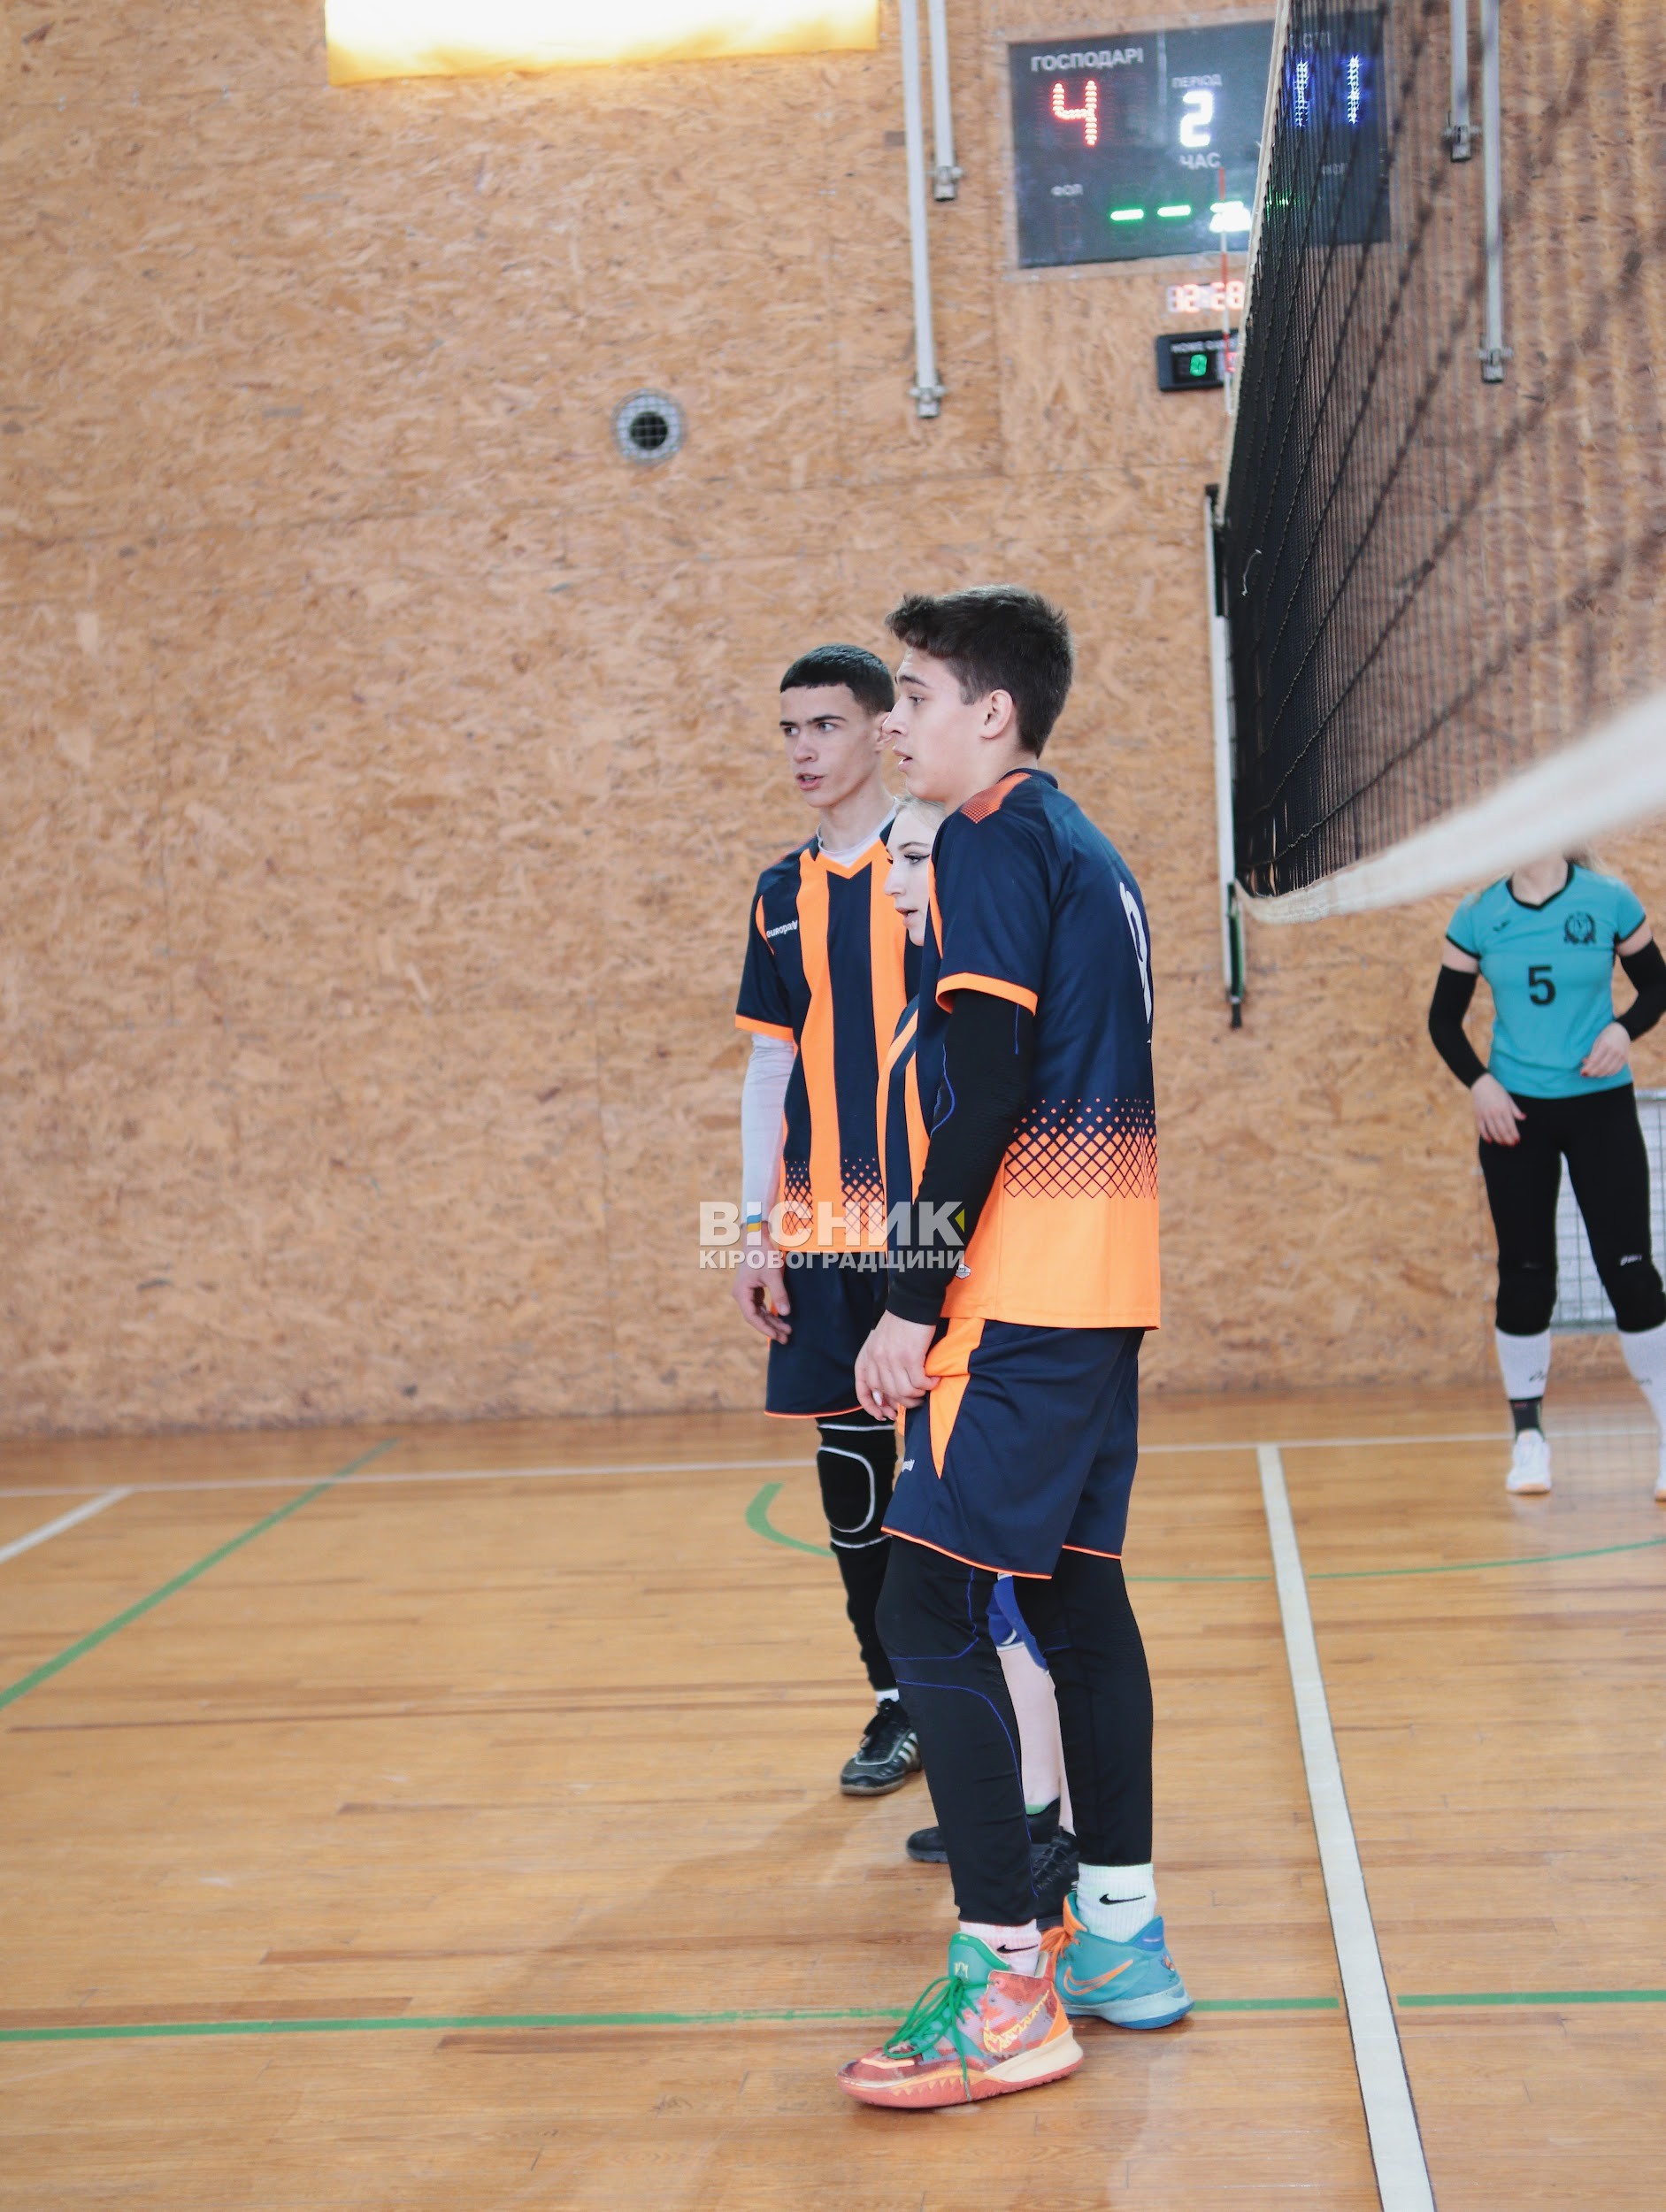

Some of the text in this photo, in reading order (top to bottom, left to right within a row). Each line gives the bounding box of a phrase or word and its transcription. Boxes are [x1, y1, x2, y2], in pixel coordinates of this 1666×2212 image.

[1030, 48, 1144, 72] ГОСПОДАРІ
[1052, 80, 1098, 146] 4
[1179, 89, 1214, 148] 2
[1179, 152, 1222, 170] ЧАС
[1528, 965, 1556, 1006] 5
